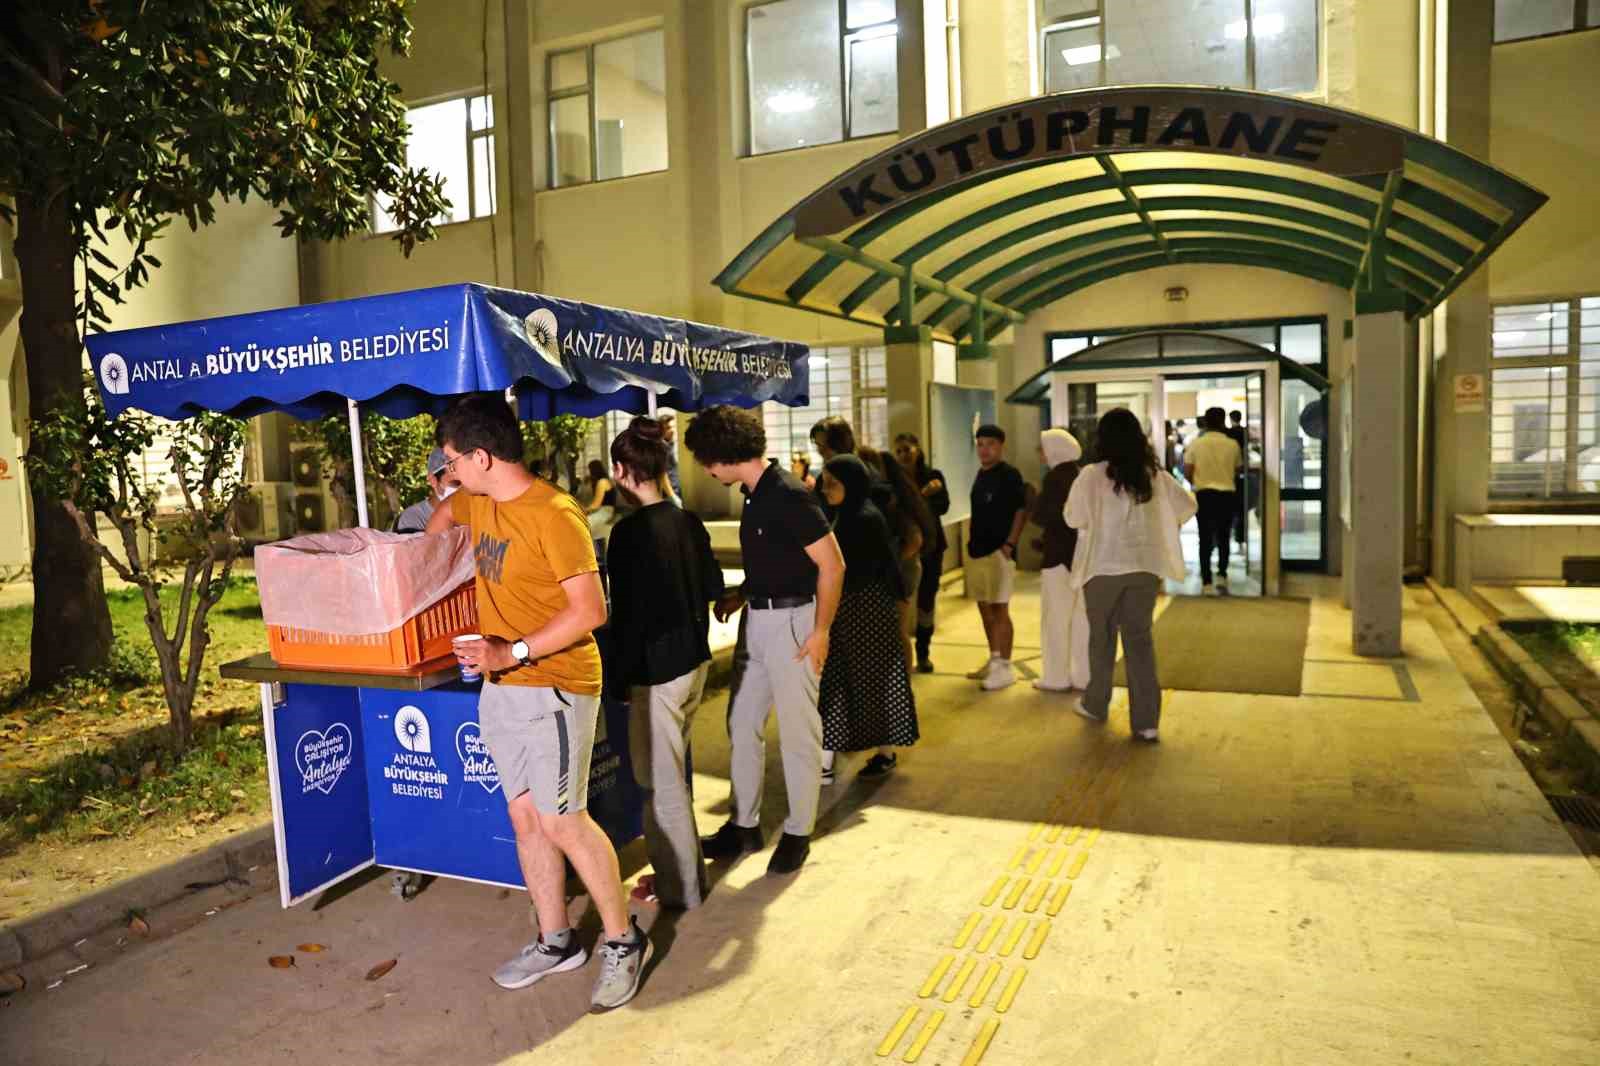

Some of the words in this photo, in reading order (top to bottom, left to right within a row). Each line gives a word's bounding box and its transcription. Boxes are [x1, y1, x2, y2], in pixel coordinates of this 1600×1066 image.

[839, 104, 1339, 217] KÜTÜPHANE
[131, 358, 201, 383] ANTALA
[206, 335, 333, 376] BÜYÜKŞEHİR
[340, 319, 449, 363] BELEDİYESİ
[563, 327, 645, 363] ANTALYA
[302, 754, 352, 786] Antalya
[393, 752, 437, 769] ANTALYA
[463, 755, 497, 775] Anta
[383, 764, 449, 785] BÜYÜKŞEHİR
[392, 782, 443, 800] BELEDİYESİ
